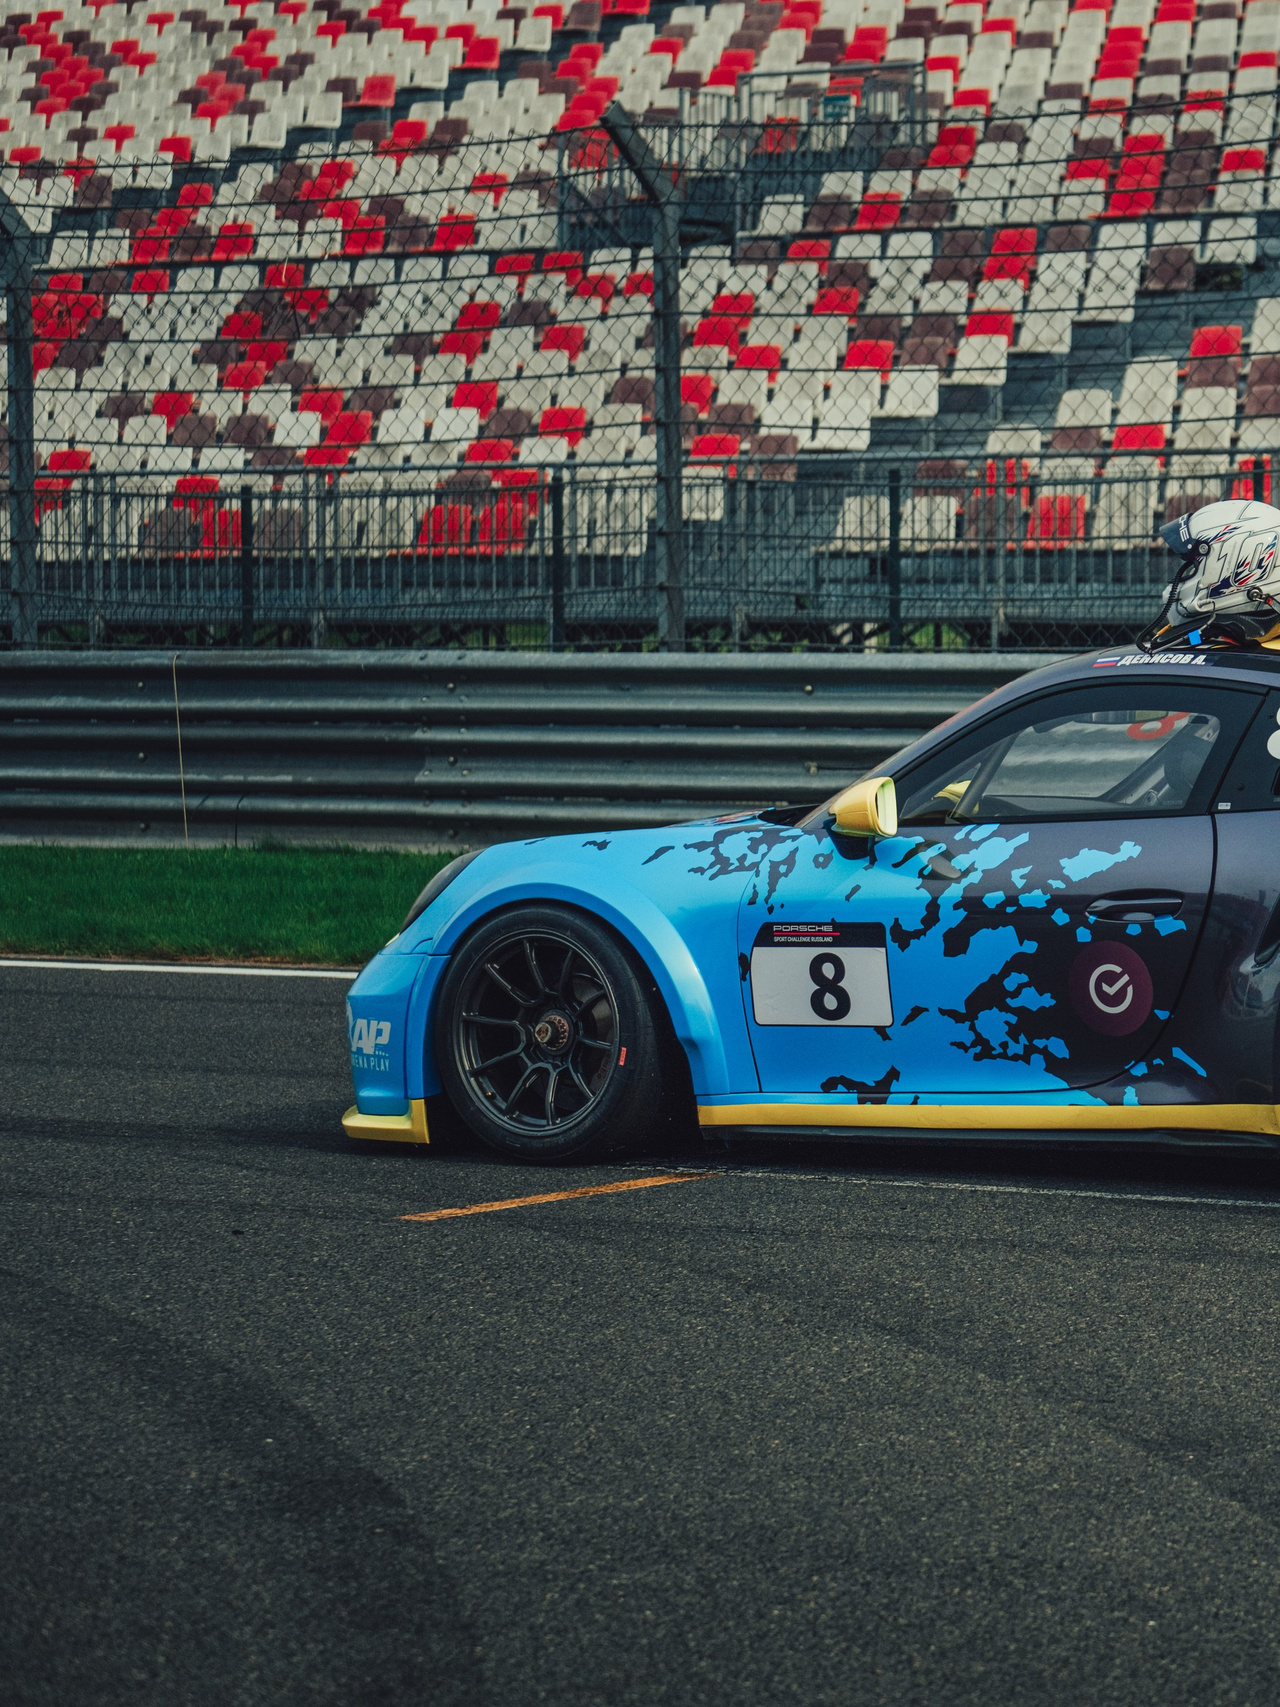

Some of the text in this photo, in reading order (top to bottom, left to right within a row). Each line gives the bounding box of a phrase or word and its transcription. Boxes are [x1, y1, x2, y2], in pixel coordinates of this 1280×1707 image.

[809, 952, 851, 1021] 8
[351, 1018, 391, 1055] AP
[370, 1057, 390, 1072] PLAY
